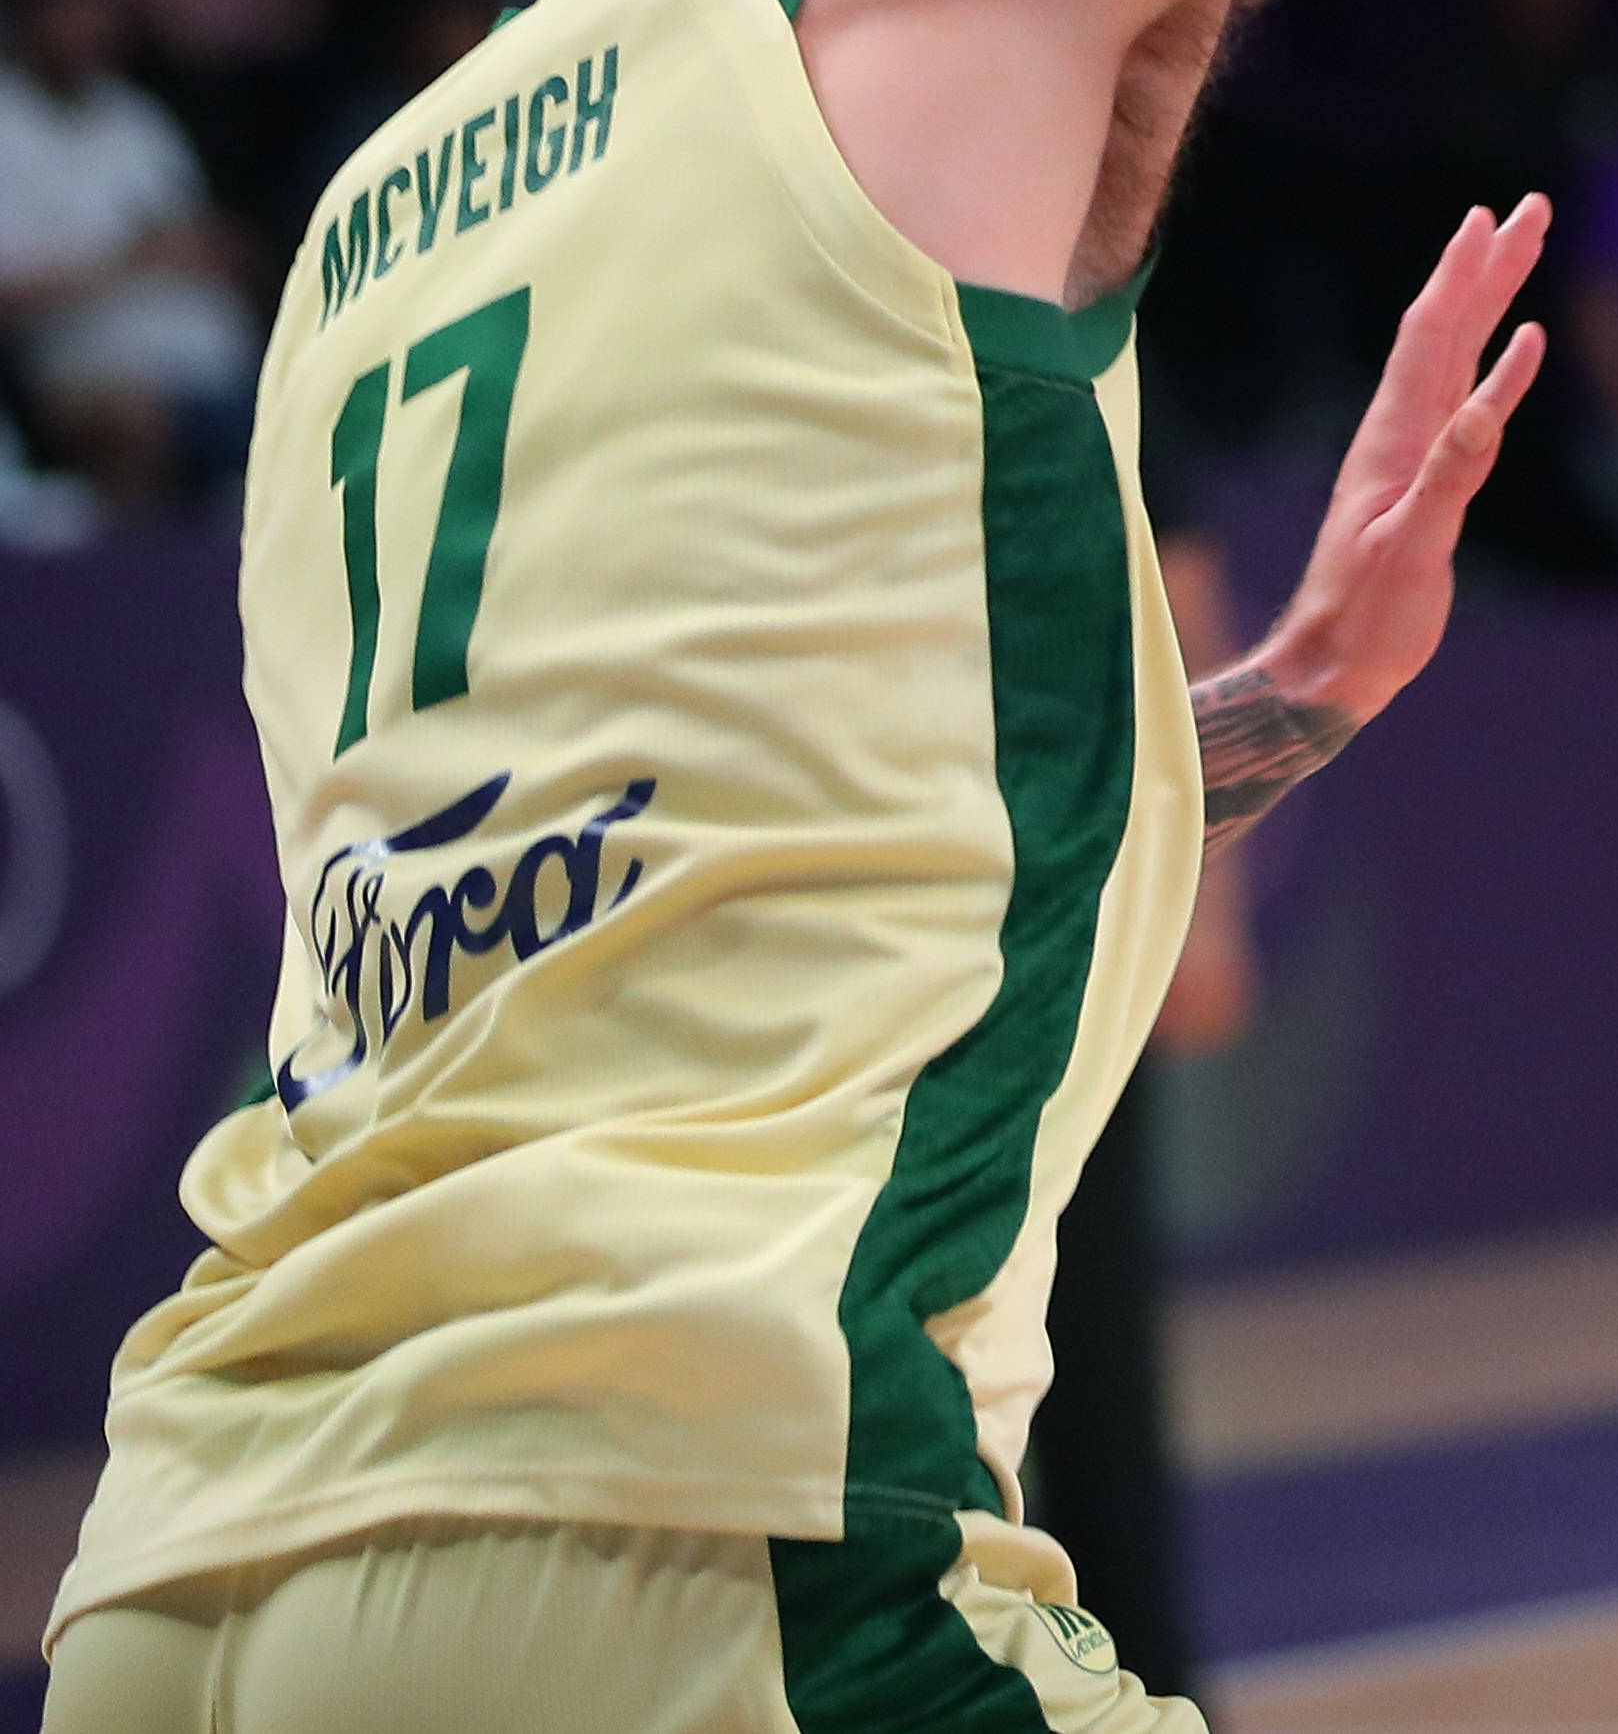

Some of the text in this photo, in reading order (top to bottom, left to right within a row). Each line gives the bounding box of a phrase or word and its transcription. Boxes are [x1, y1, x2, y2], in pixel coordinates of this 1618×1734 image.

[317, 43, 620, 332] MCVEIGH
[330, 284, 532, 762] 17
[276, 768, 658, 1114] Ford
